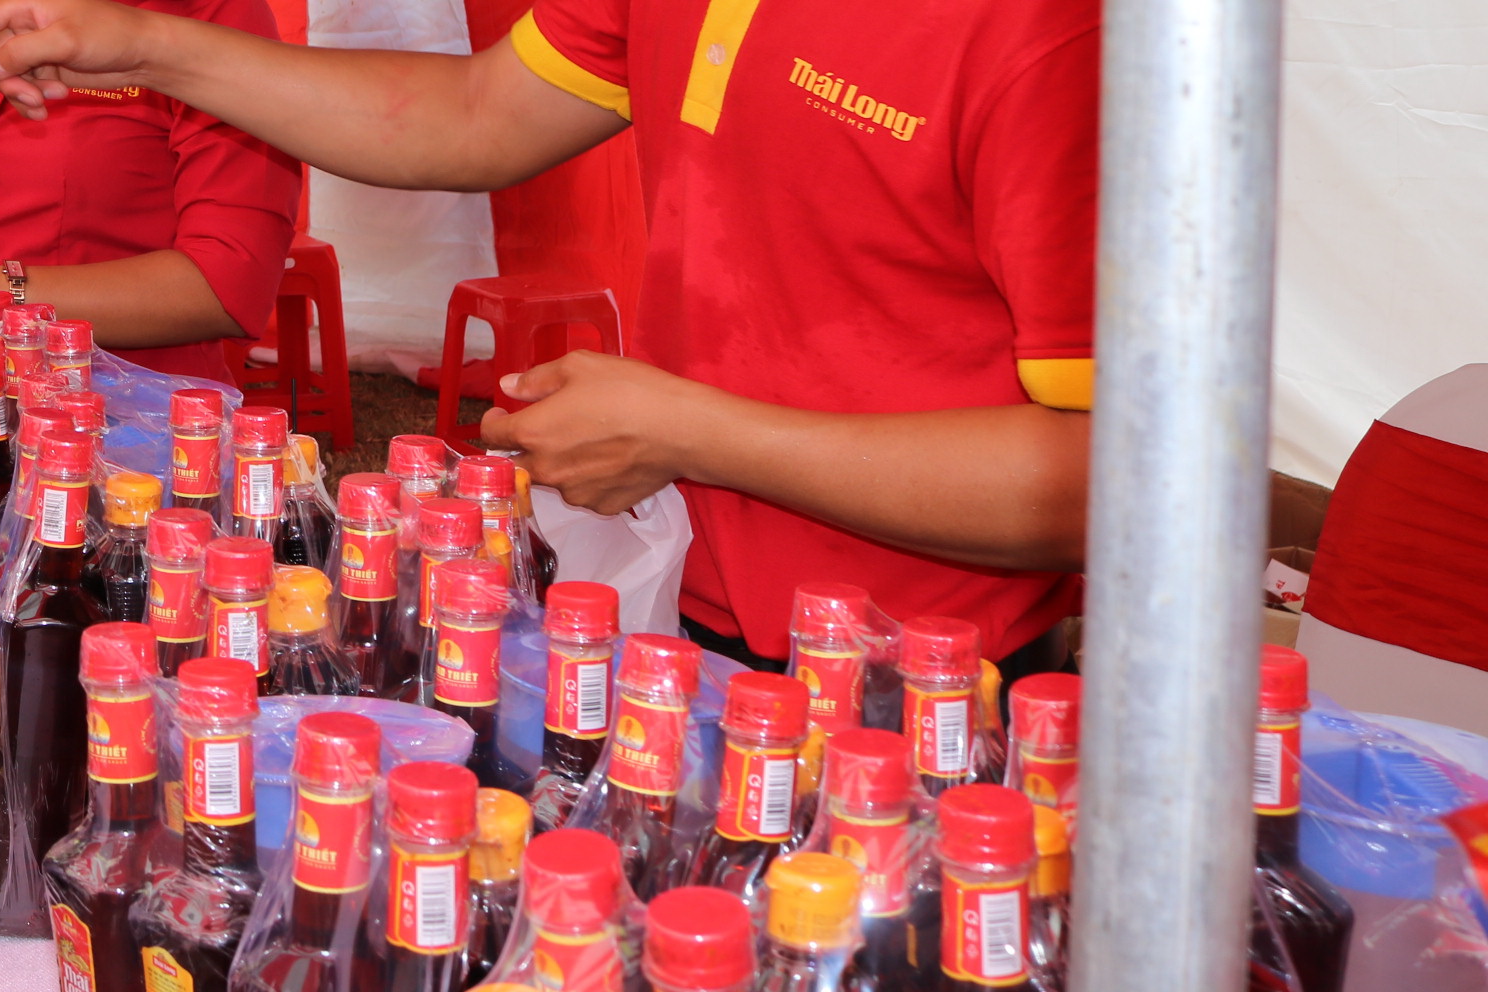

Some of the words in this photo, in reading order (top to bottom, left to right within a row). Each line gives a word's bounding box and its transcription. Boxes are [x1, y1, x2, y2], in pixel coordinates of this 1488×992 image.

[72, 87, 123, 101] CONSUMER
[788, 57, 846, 104] Thái
[840, 84, 920, 142] Long
[805, 97, 876, 135] CONSUMER
[351, 568, 377, 579] THIẾT
[153, 605, 177, 619] THIẾT
[447, 669, 479, 682] THIẾT
[95, 743, 128, 758] THIẾT
[624, 746, 660, 766] THIẾT
[301, 844, 338, 863] THIẾT
[62, 960, 89, 992] Thái
